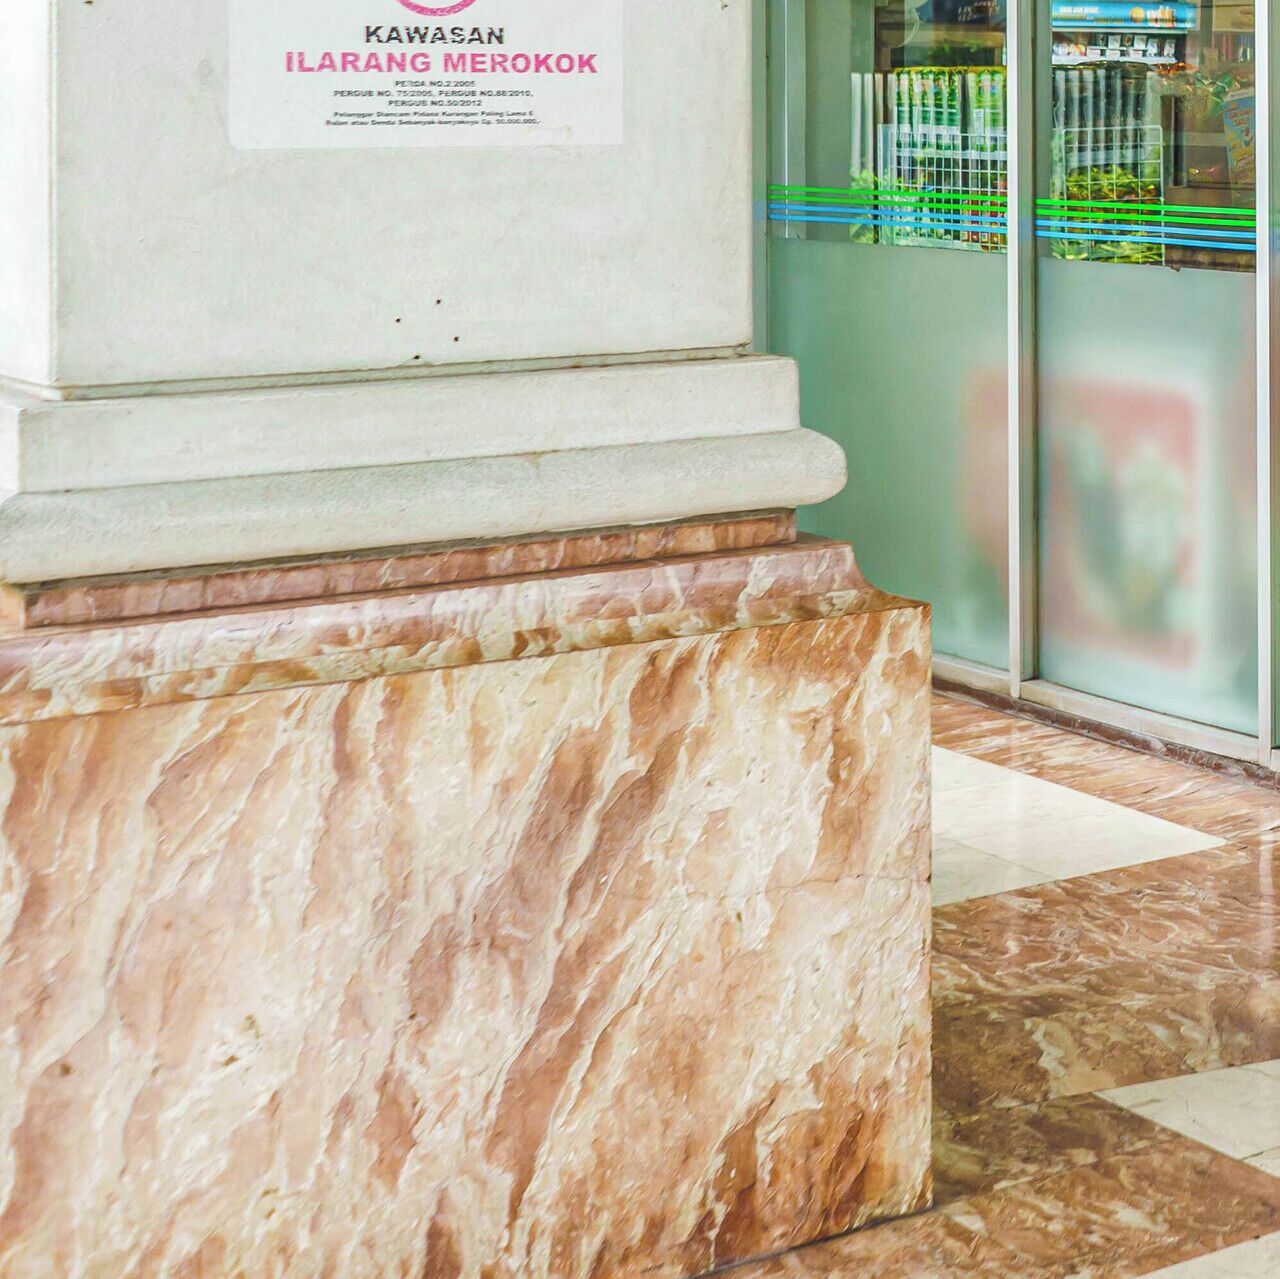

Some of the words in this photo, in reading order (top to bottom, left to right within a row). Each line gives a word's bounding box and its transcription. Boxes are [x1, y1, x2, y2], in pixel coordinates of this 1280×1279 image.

[364, 25, 505, 45] KAWASAN
[286, 51, 431, 73] ILARANG
[444, 52, 597, 74] MEROKOK
